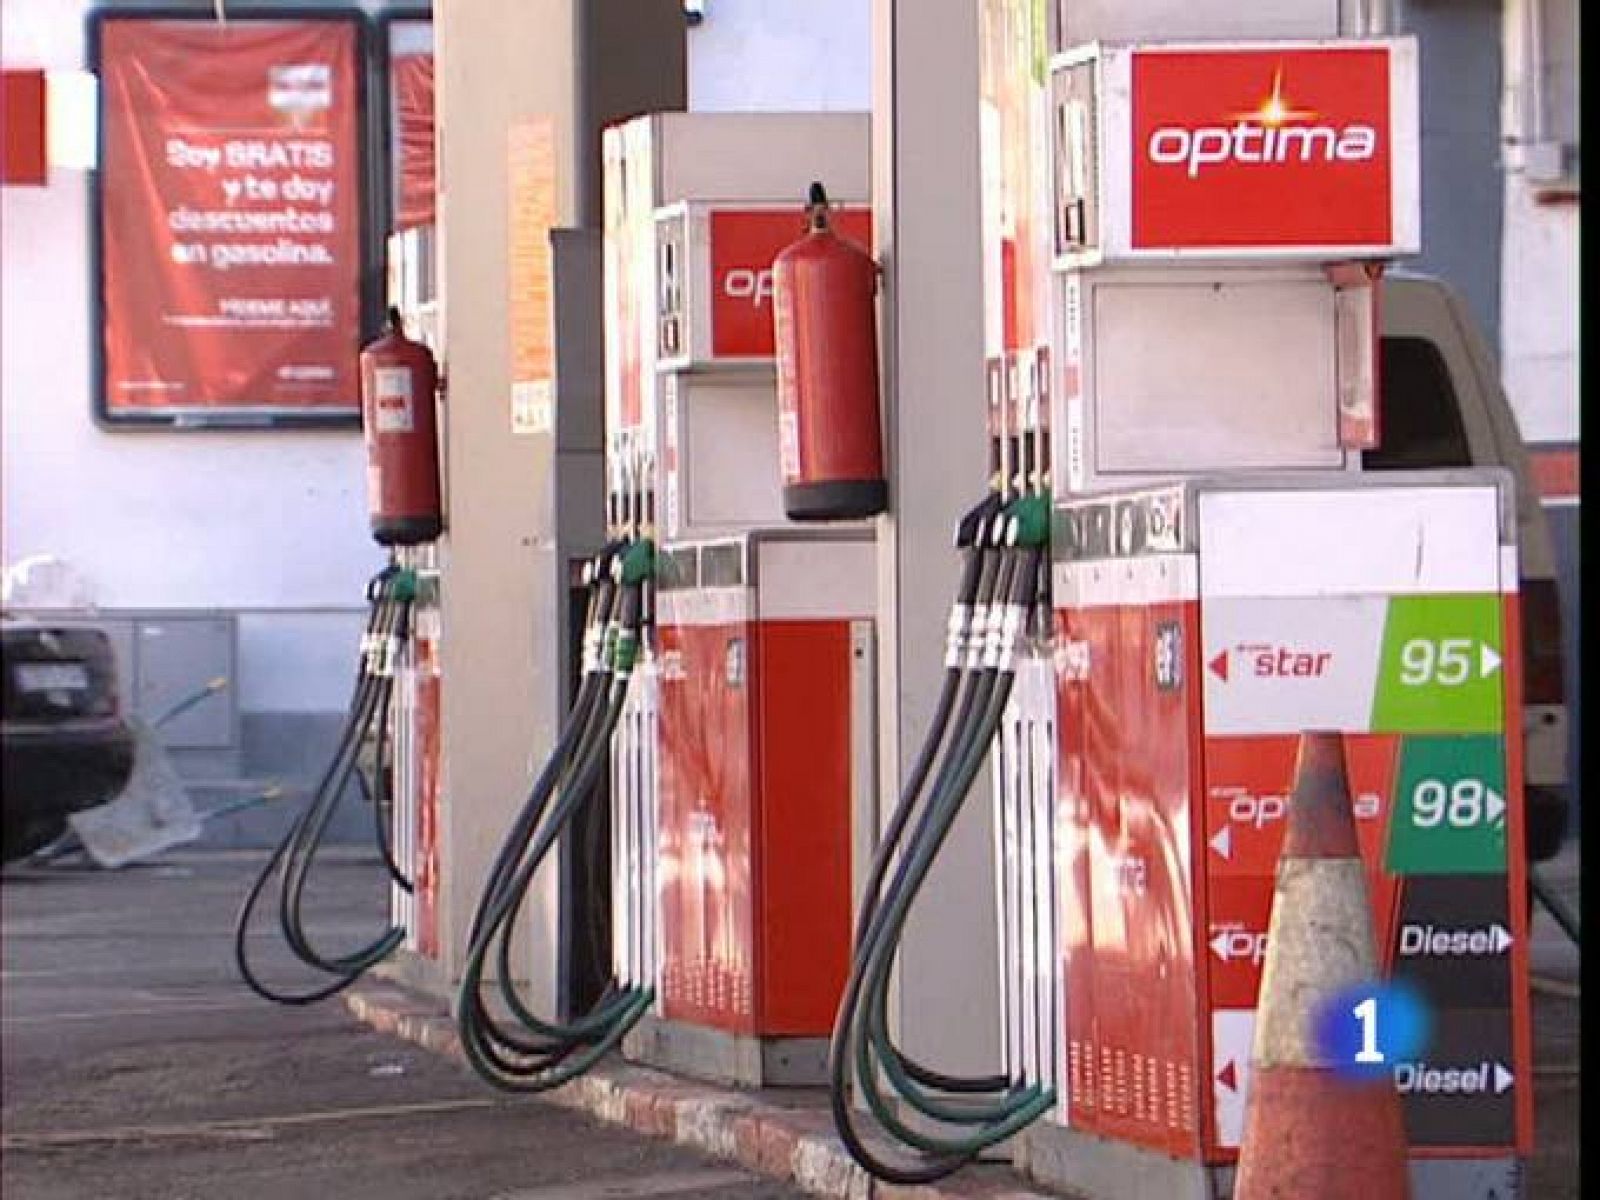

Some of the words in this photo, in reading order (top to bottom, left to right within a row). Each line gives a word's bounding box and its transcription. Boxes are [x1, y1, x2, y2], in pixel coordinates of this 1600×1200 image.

[165, 139, 222, 173] Soy
[224, 140, 334, 168] GRATIS
[1149, 120, 1376, 179] optima
[723, 270, 775, 308] op
[1254, 647, 1333, 678] star
[1400, 639, 1472, 686] 95
[1411, 778, 1484, 828] 98
[1400, 924, 1500, 955] Diesel
[1393, 1062, 1488, 1094] Diesel
